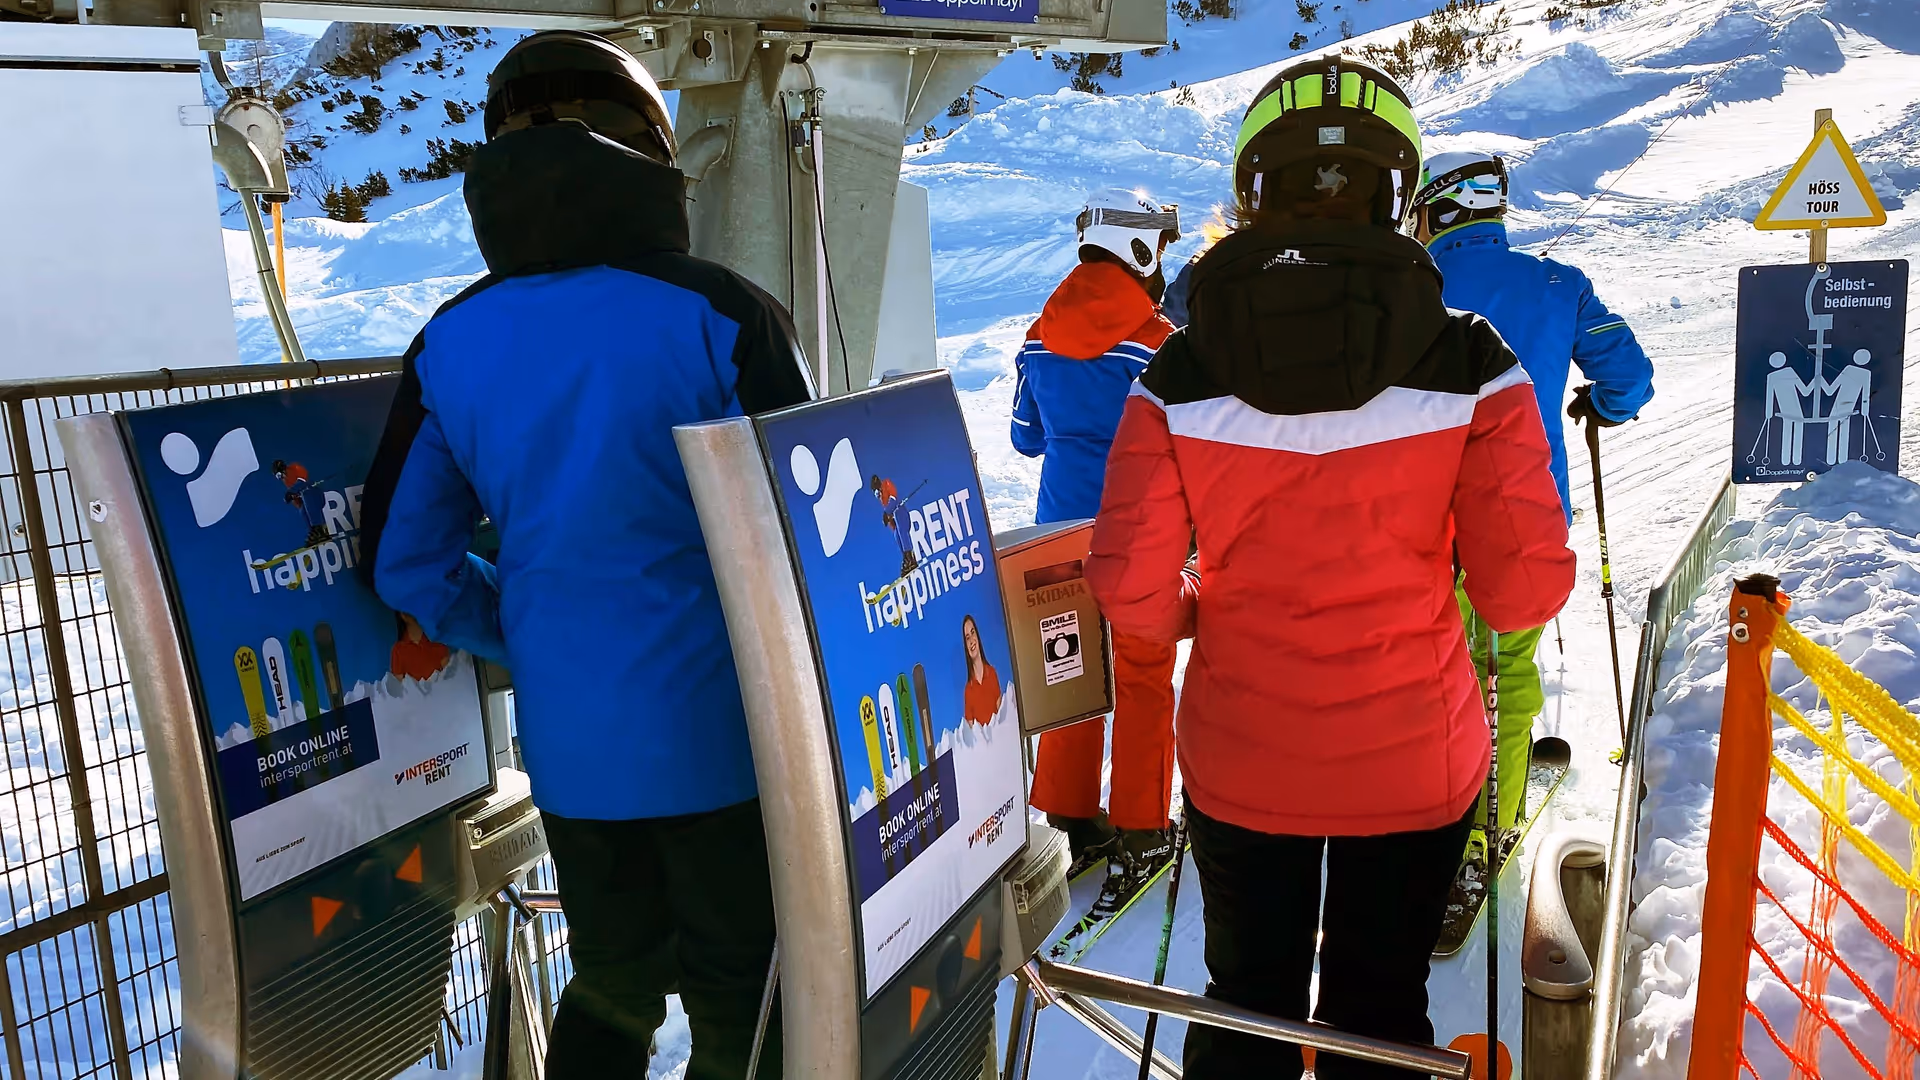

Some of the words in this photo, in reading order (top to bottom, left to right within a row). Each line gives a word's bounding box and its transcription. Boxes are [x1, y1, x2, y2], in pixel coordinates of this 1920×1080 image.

[1326, 65, 1338, 95] bollé
[1808, 180, 1840, 195] HÖSS
[1806, 200, 1839, 213] TOUR
[1824, 295, 1892, 308] bedienung
[908, 488, 974, 561] RENT
[858, 540, 984, 633] happiness
[1026, 584, 1086, 607] SKIDATA
[1041, 613, 1076, 628] SMILE
[268, 656, 287, 710] HEAD
[257, 745, 297, 772] BOOK
[300, 725, 349, 755] ONLINE
[883, 705, 898, 769] HEAD
[260, 742, 353, 788] intersportrent.at
[405, 743, 468, 780] INTERSPORT
[425, 764, 451, 785] RENT
[879, 809, 906, 844] BOOK
[907, 782, 940, 821] ONLINE
[881, 801, 943, 862] intersportrent.at
[974, 795, 1015, 843] INTERSPORT
[986, 820, 1003, 847] RENT
[1142, 845, 1170, 858] HEAD
